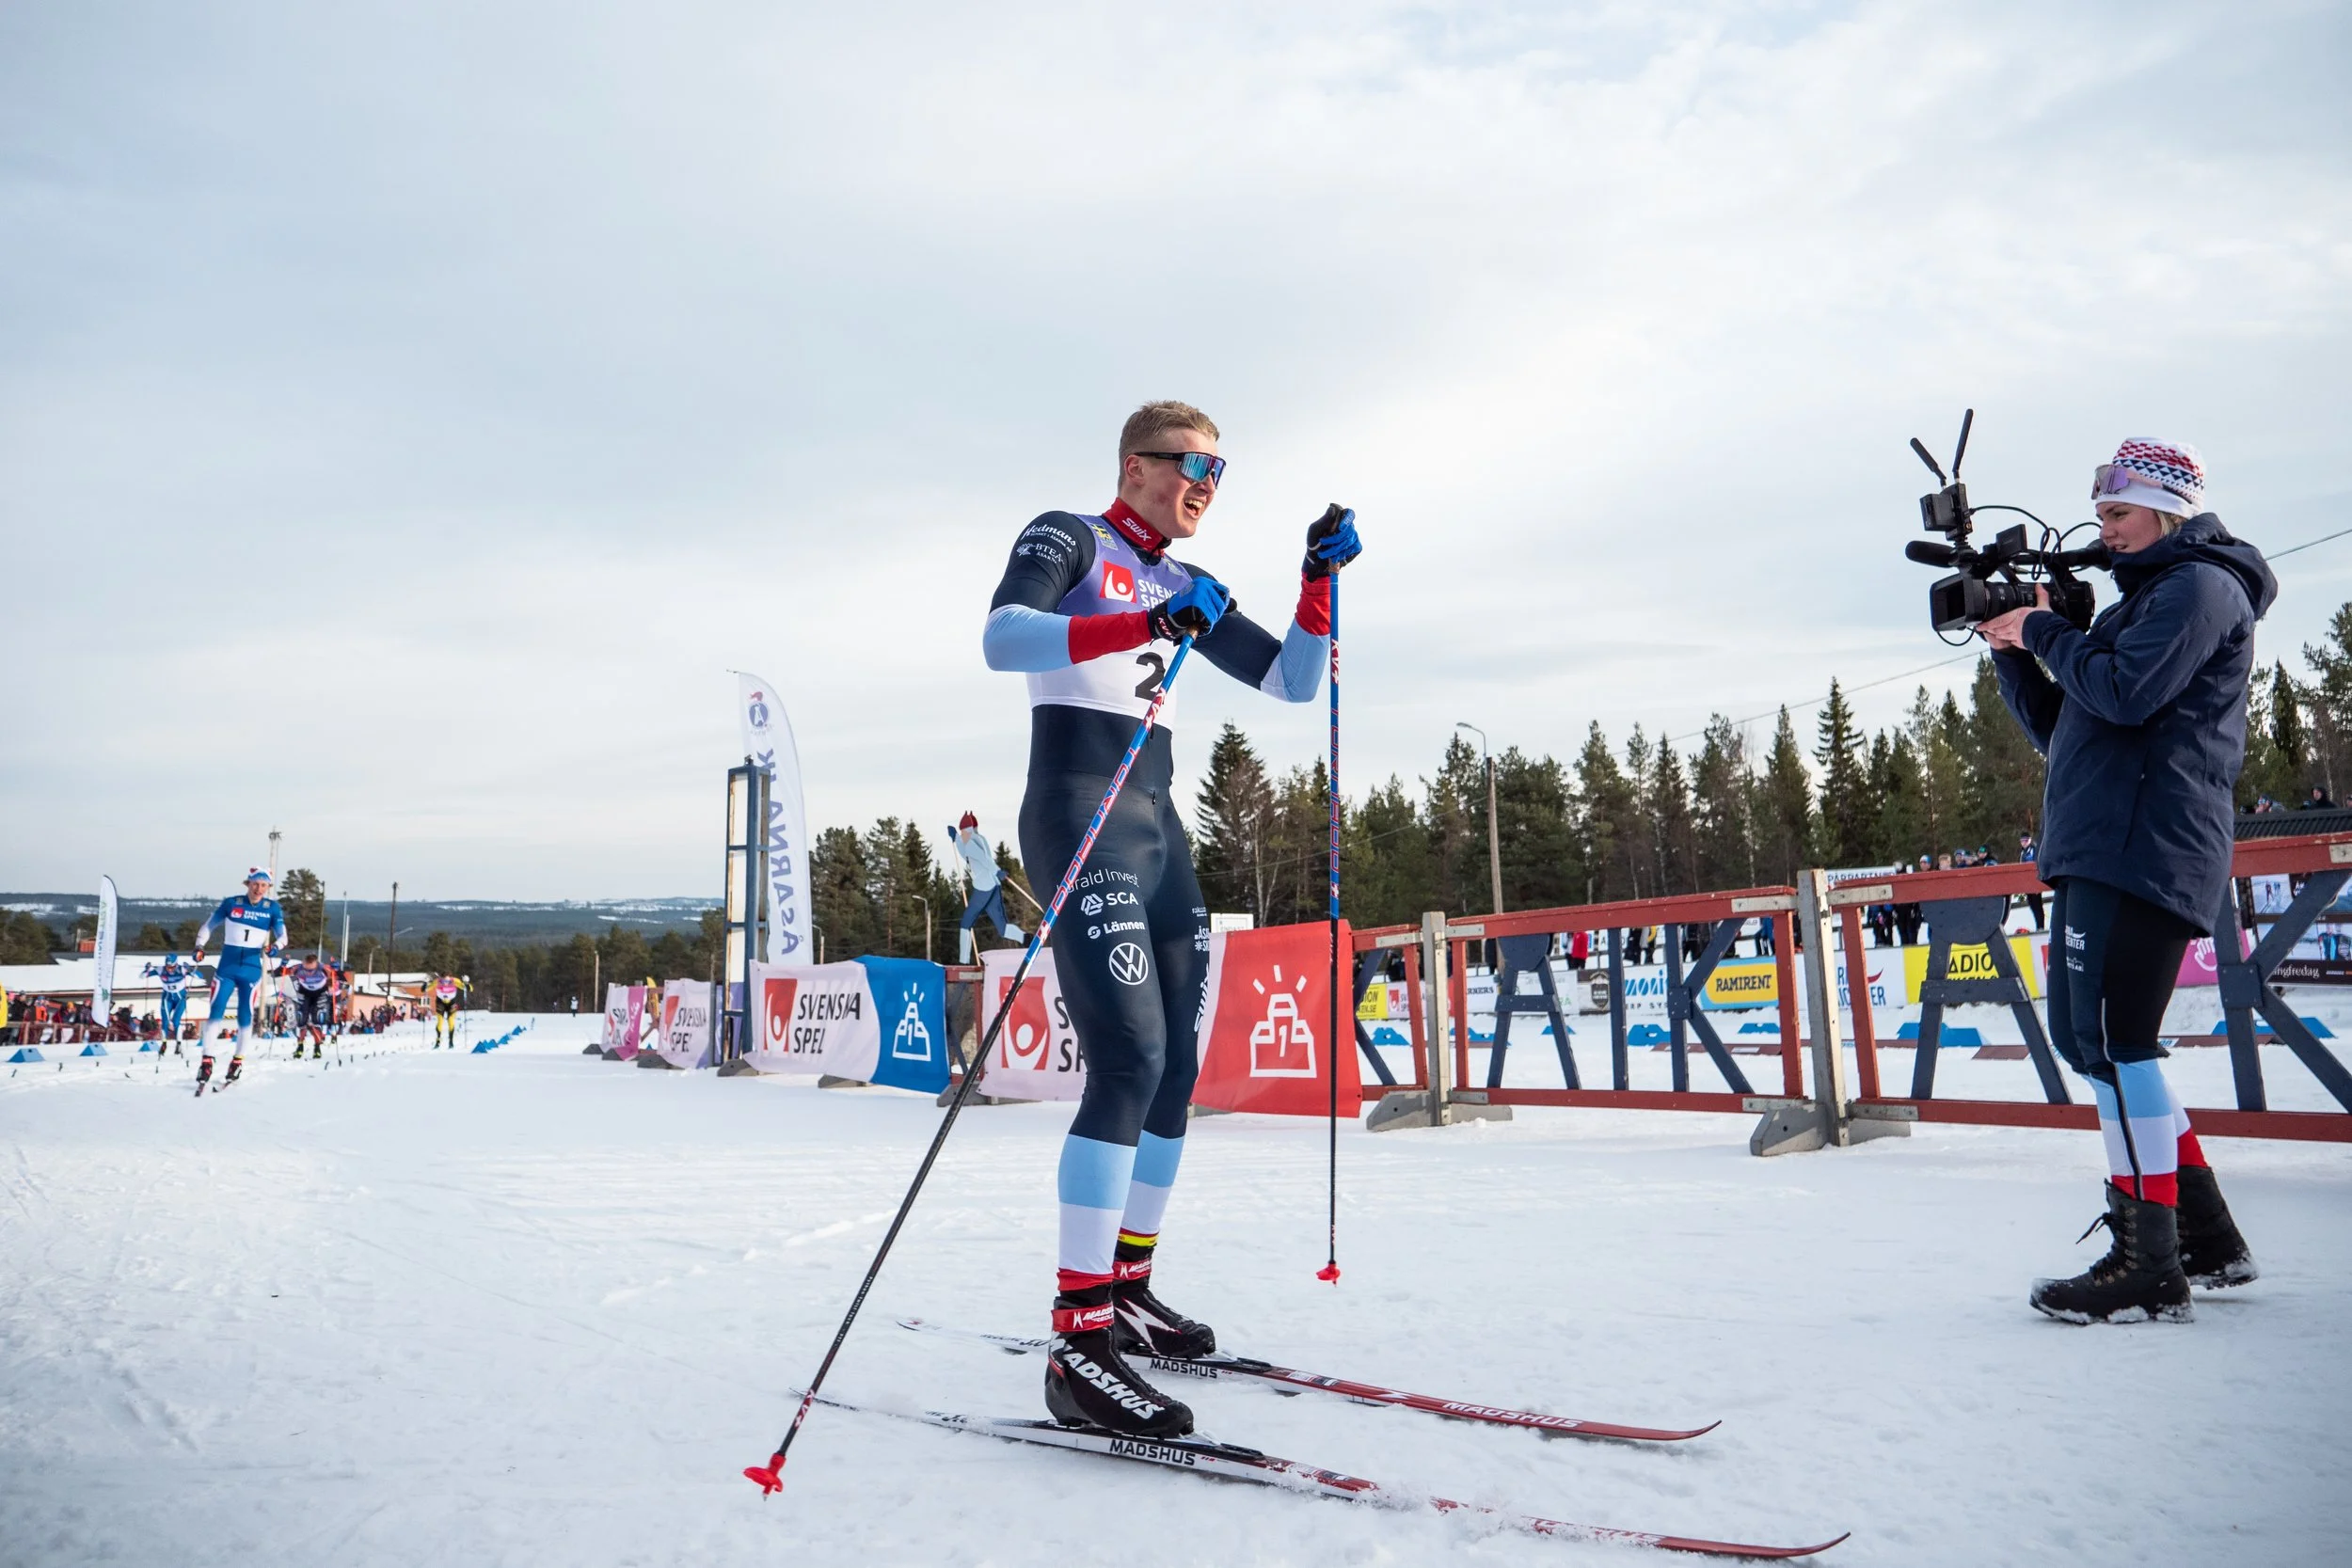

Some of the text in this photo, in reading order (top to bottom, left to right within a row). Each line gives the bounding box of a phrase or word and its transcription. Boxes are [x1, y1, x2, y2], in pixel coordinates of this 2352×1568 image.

[1135, 652, 1167, 702] 2
[1105, 892, 1138, 907] SCA
[245, 929, 250, 942] 1
[1104, 921, 1146, 934] Lännen
[1715, 974, 1772, 992] RAMIRENT
[798, 992, 862, 1021] SVENSKA
[792, 1027, 825, 1054] SPEL
[1150, 1358, 1218, 1379] MADSHUS
[1109, 1439, 1196, 1467] MADSHUS
